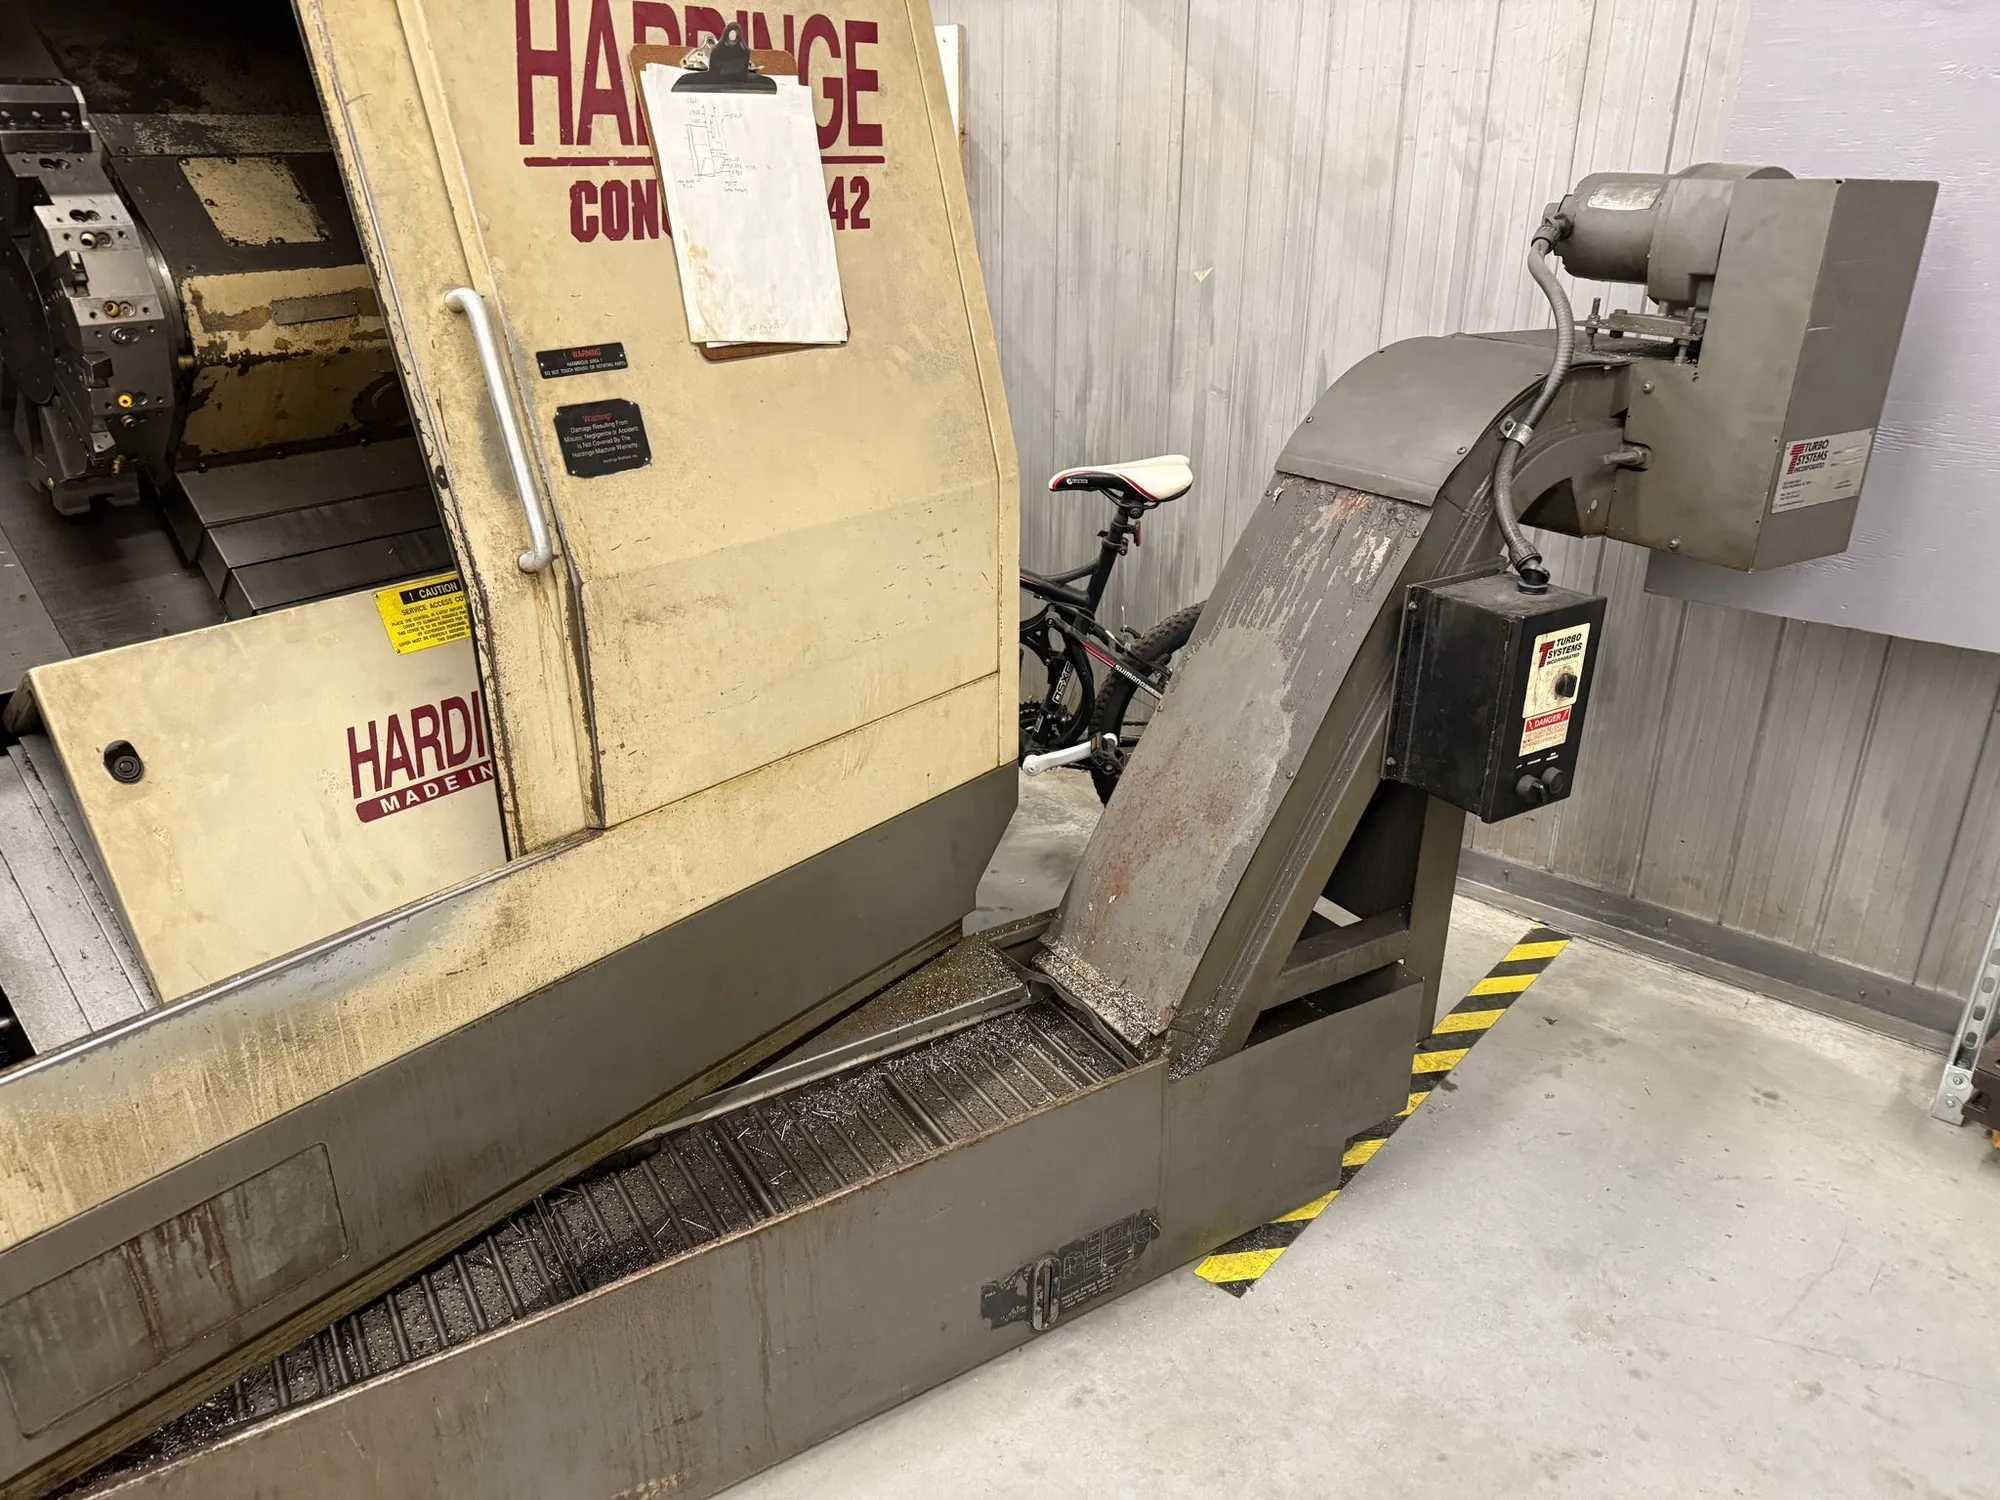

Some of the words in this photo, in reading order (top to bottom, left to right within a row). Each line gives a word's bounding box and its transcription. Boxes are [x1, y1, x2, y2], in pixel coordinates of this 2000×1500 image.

[592, 421, 614, 430] Resulting
[584, 429, 611, 440] Negligence
[1804, 440, 1830, 452] TURBO
[1796, 451, 1828, 465] SYSTEMS
[418, 582, 458, 599] CAUTION
[400, 603, 427, 615] SERVICE
[429, 597, 453, 608] ACCESS
[1556, 633, 1582, 647] TURBO
[1548, 642, 1583, 659] SYSTEMS
[1534, 713, 1561, 727] DANGER
[347, 691, 489, 799] HARDI
[380, 775, 460, 815] MADE
